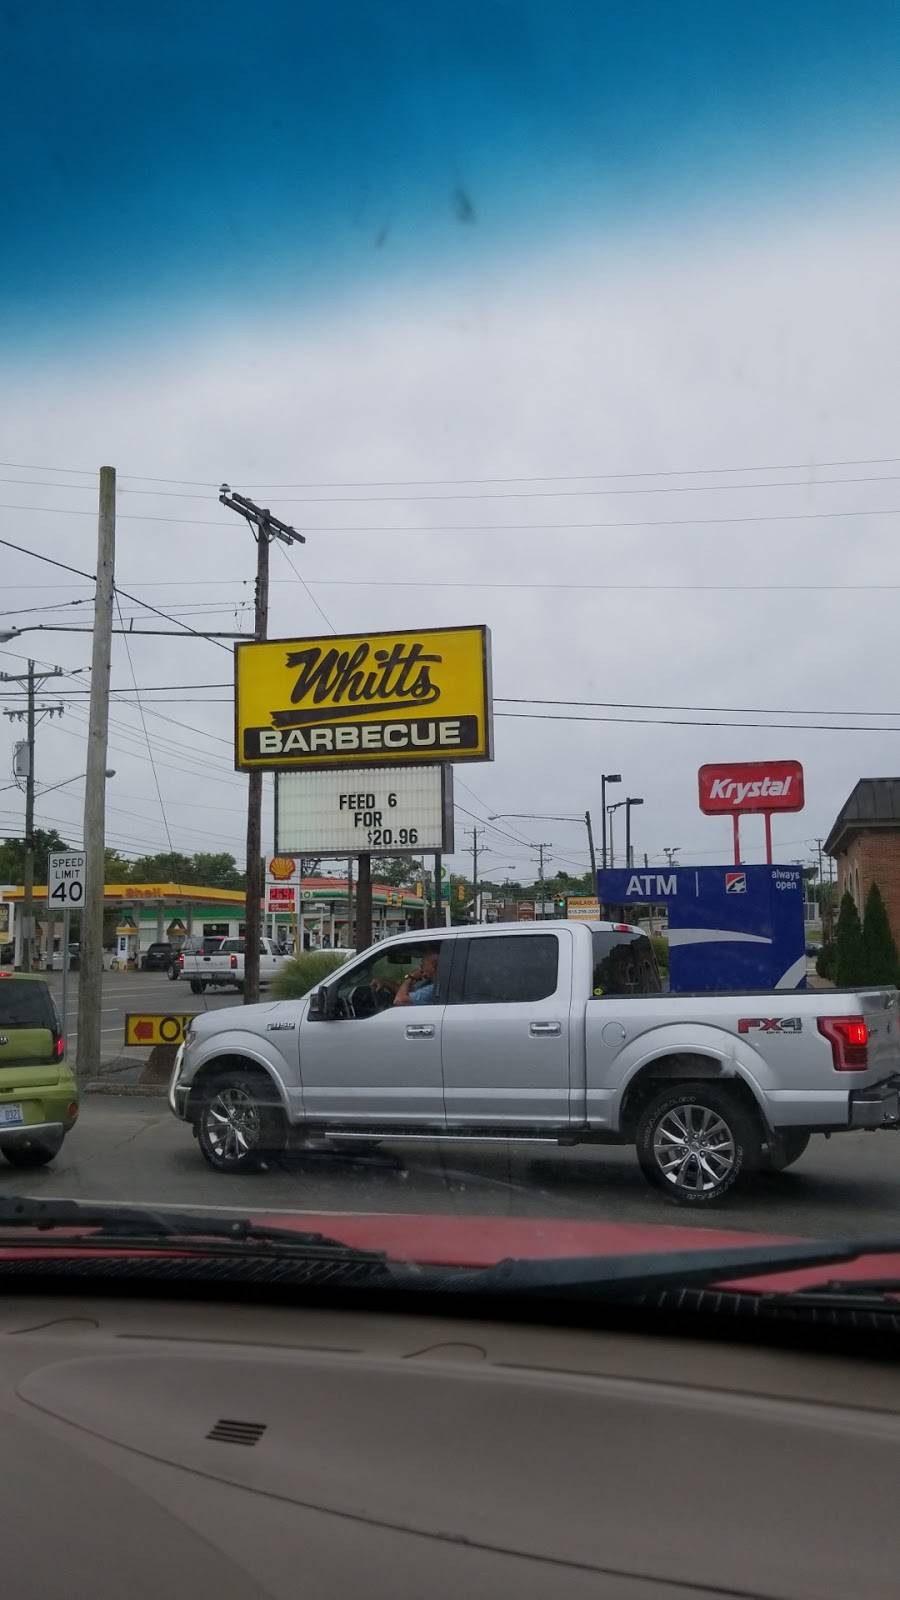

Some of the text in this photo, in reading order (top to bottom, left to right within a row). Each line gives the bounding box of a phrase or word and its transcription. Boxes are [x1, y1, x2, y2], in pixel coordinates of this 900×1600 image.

[285, 642, 442, 712] Whitts
[259, 721, 461, 754] BARBECUE
[709, 776, 793, 804] Krystal
[339, 793, 398, 811] FEED 6
[354, 812, 383, 828] FOR
[367, 828, 419, 846] $20.96
[52, 857, 84, 868] SPEED
[55, 870, 80, 880] LIMIT
[771, 869, 800, 882] always
[51, 881, 84, 902] 40
[125, 887, 160, 898] Shell
[626, 874, 677, 896] ATM
[775, 881, 798, 891] open
[738, 1018, 803, 1034] FX4
